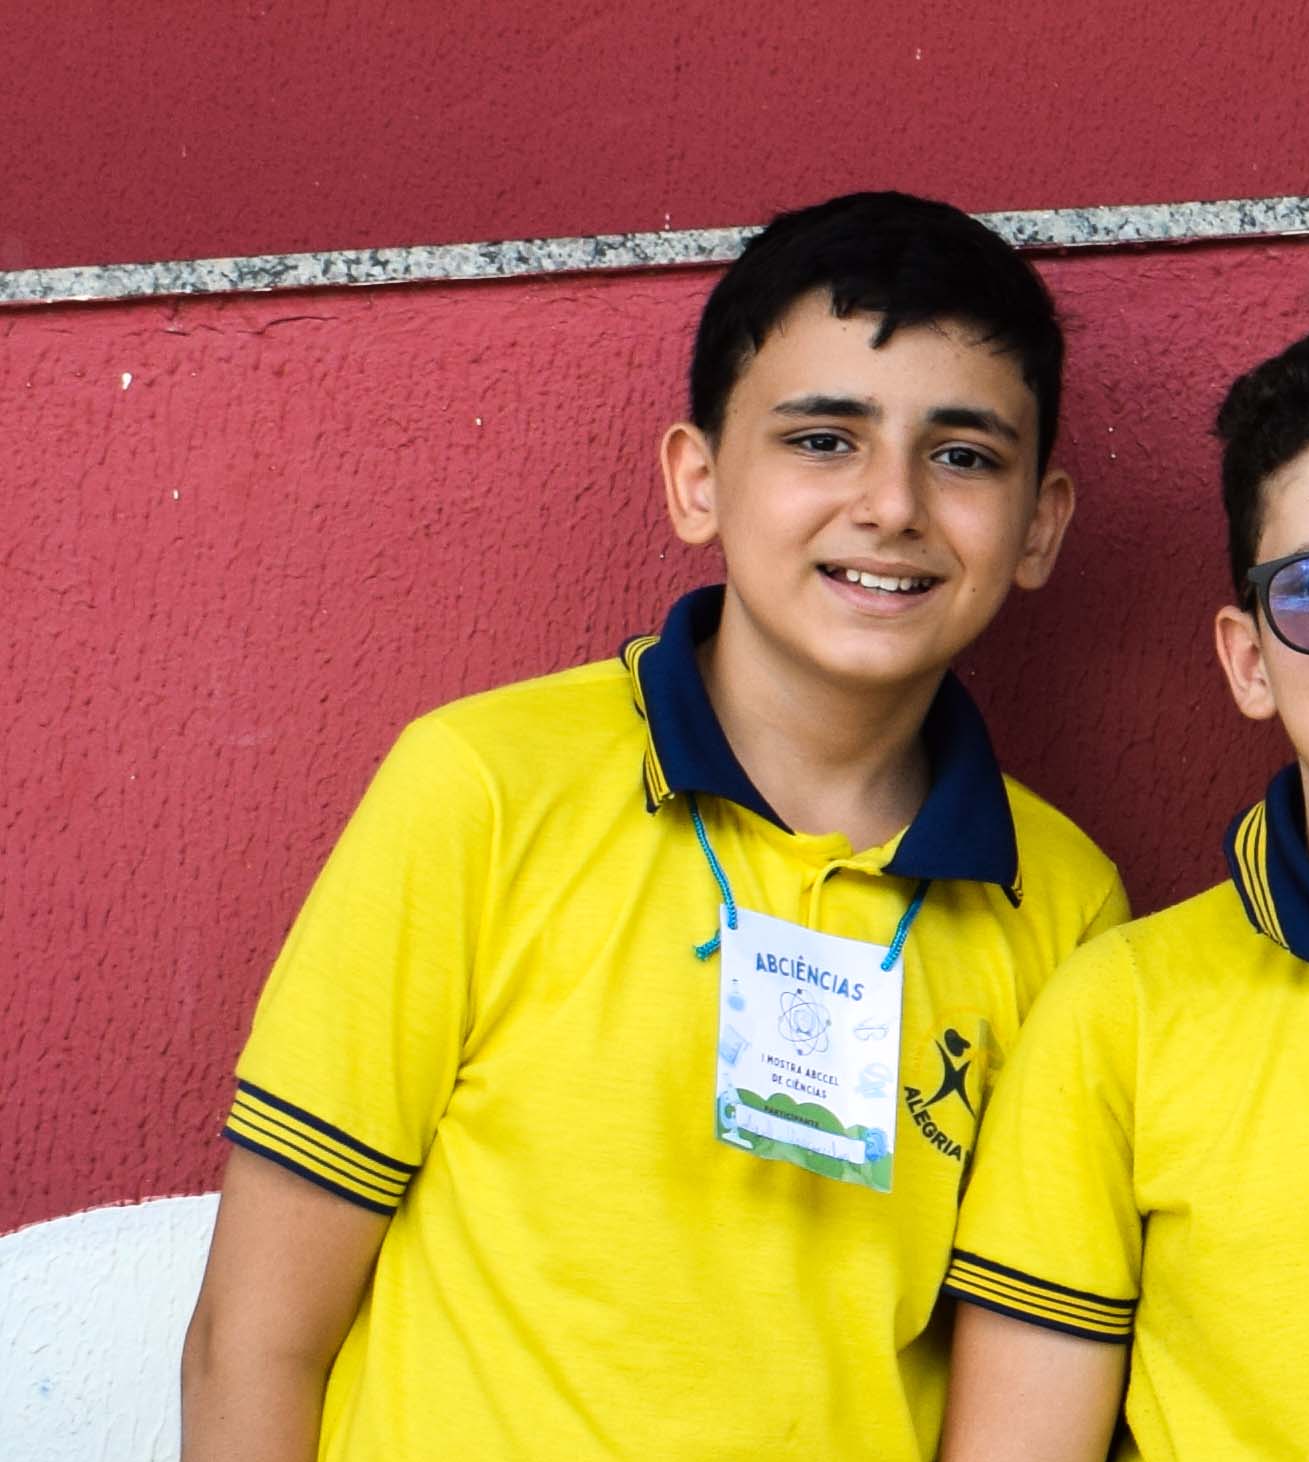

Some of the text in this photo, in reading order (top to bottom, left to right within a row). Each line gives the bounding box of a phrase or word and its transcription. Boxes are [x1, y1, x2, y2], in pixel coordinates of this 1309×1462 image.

[755, 951, 865, 1002] ABCIÊNCIAS
[766, 1053, 802, 1076] MOSTRA
[785, 1075, 828, 1100] CIÊNCIAS
[904, 1086, 963, 1162] ALEGRIA
